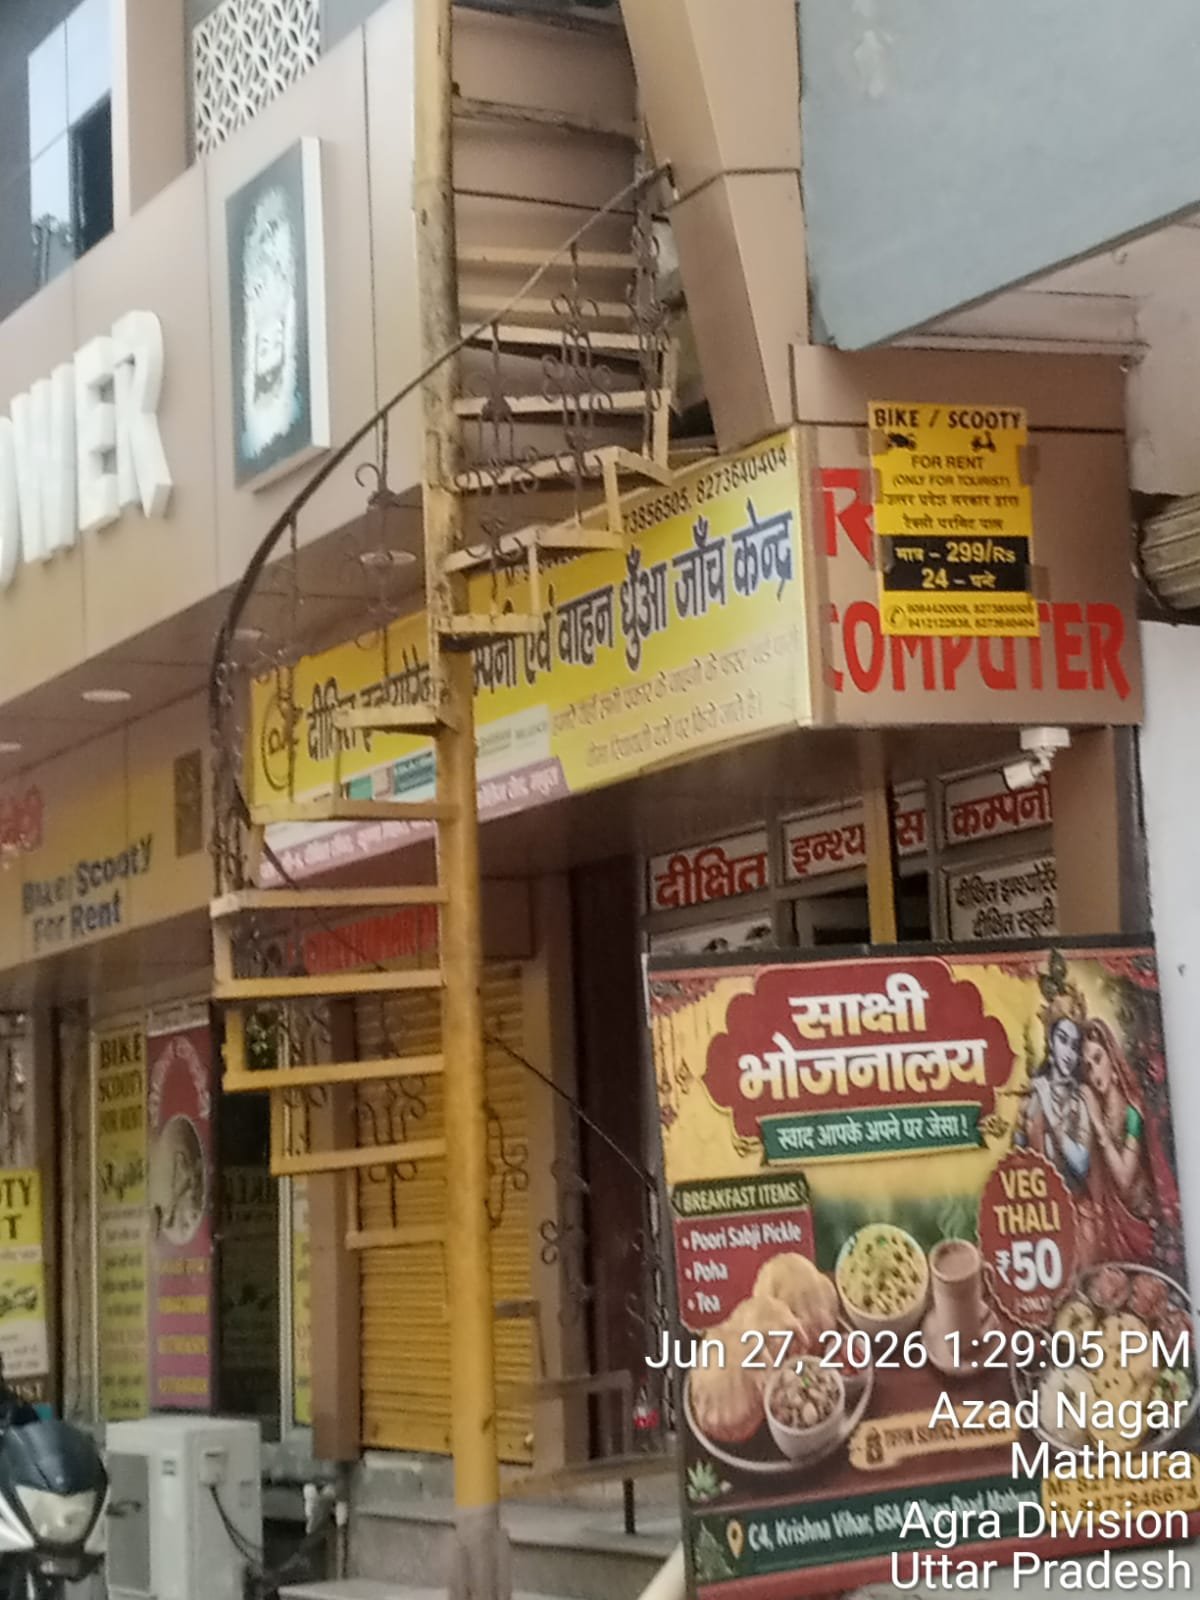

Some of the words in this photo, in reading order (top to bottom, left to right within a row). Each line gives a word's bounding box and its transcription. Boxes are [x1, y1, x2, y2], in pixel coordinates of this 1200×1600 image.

[874, 408, 919, 428] BIKE
[947, 408, 1021, 430] SCOOTY
[911, 455, 942, 470] FOR
[944, 455, 984, 470] RENT
[945, 538, 1017, 564] 299/Rs
[556, 584, 615, 666] वाहन
[619, 543, 669, 672] धुँआ
[672, 514, 727, 625] जाँच
[920, 567, 950, 589] 24
[653, 846, 768, 907] दीक्षित
[69, 888, 121, 941] Rent
[787, 972, 930, 1040] साक्षी
[737, 1031, 989, 1101] भोजनालय
[776, 1124, 817, 1151] स्वाद
[817, 1115, 863, 1149] आपके
[865, 1113, 902, 1146] अपने
[682, 1184, 757, 1213] BREAKFAST
[757, 1181, 800, 1206] ITEMS
[999, 1166, 1048, 1200] VEG
[993, 1200, 1062, 1236] THALI
[689, 1226, 728, 1252] Poori
[761, 1219, 802, 1244] Pickle
[692, 1258, 729, 1283] Poha
[993, 1237, 1063, 1293] ₹50
[694, 1290, 721, 1313] Tea
[775, 1514, 832, 1548] Krishna
